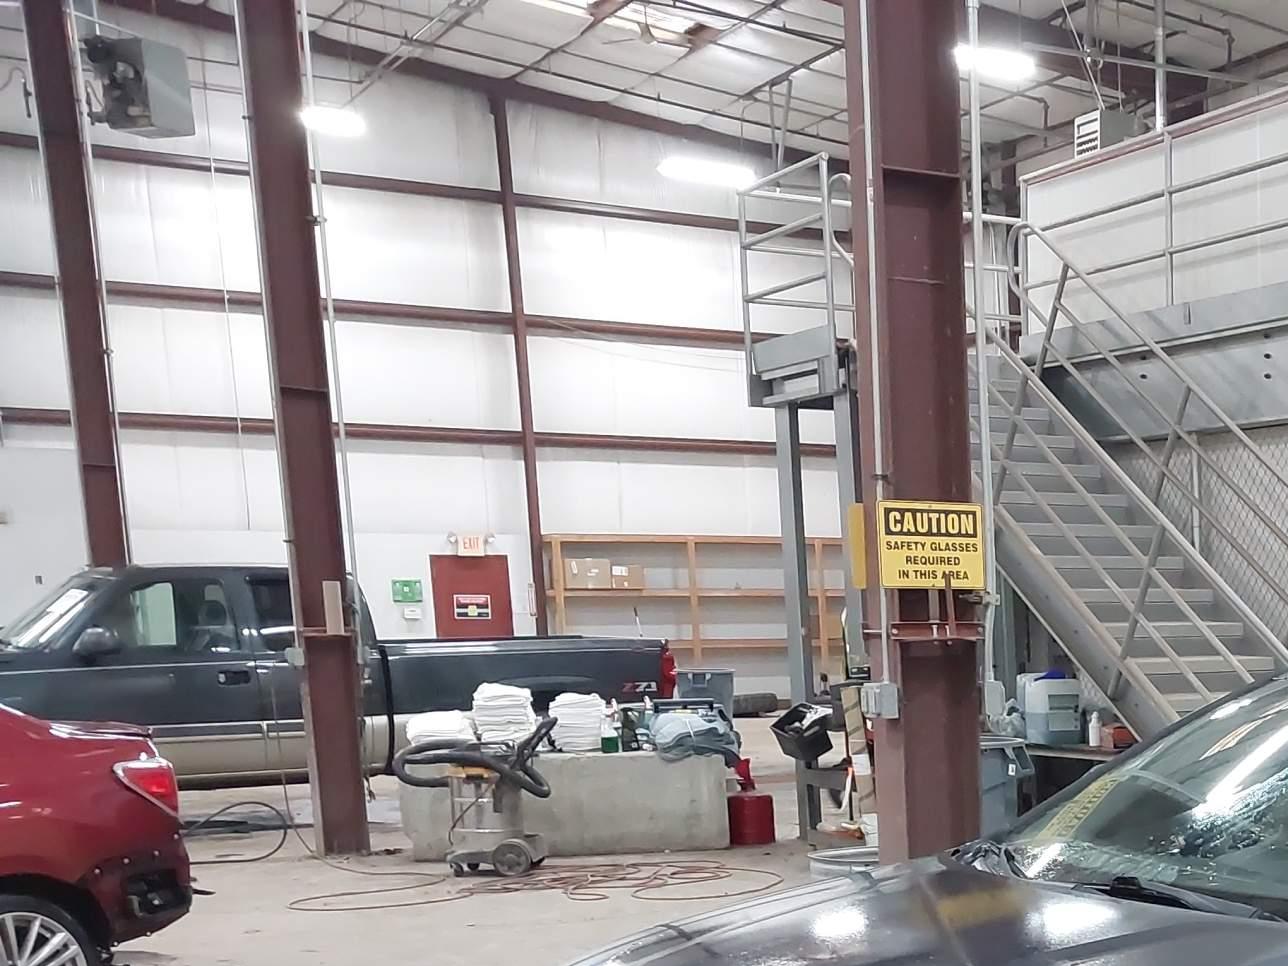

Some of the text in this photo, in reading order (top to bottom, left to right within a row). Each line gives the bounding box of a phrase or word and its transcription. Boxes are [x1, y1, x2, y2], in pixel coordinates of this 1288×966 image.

[888, 511, 974, 534] CAUTION
[463, 537, 480, 549] EXIT
[886, 541, 978, 552] SAFETY GLASSES
[906, 556, 960, 565] REQUIRED
[898, 570, 969, 580] IN THIS AREA
[622, 681, 657, 693] Z71
